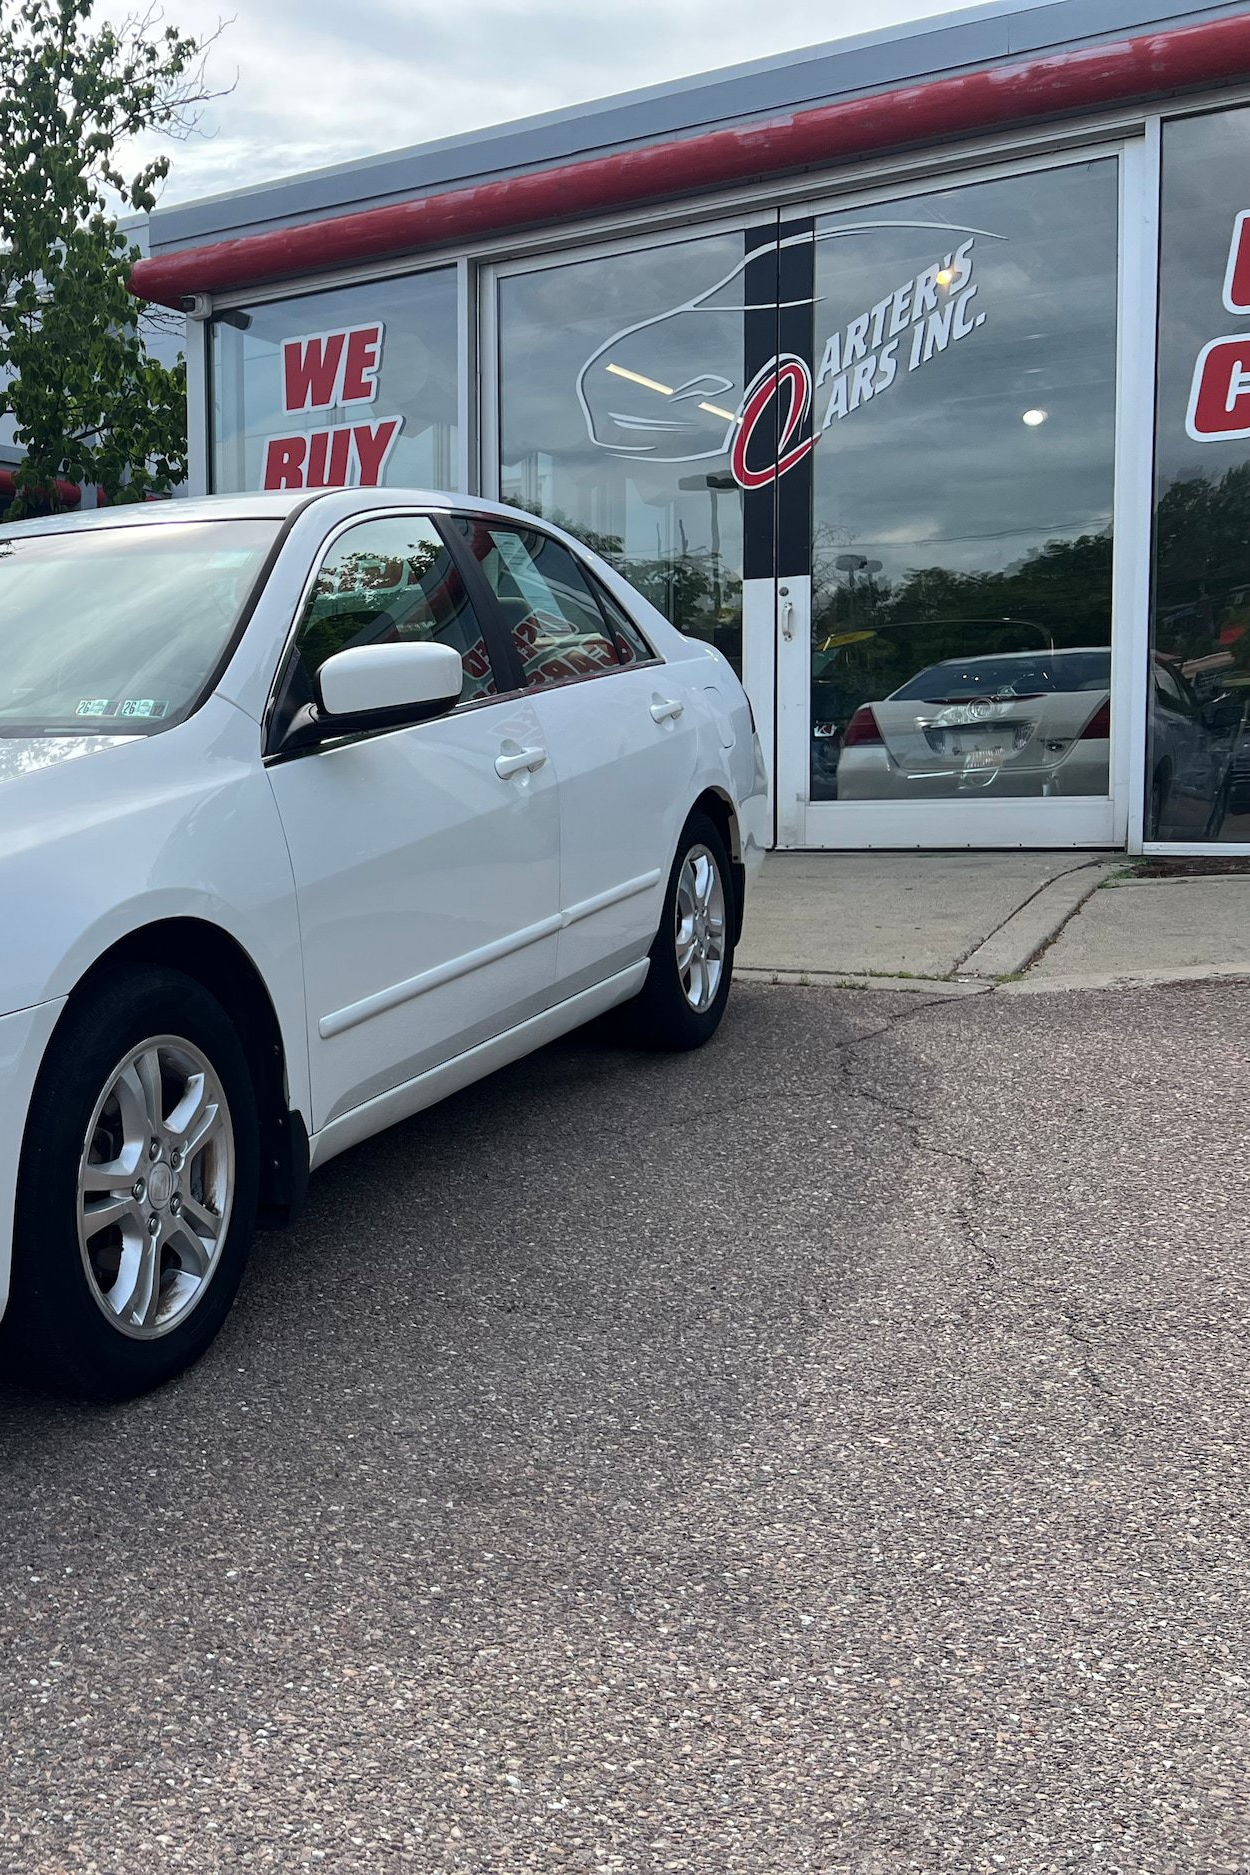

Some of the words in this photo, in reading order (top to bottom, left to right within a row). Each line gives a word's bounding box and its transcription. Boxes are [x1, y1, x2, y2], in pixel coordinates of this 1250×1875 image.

[282, 323, 383, 414] WE
[909, 285, 987, 372] INC.
[262, 417, 402, 491] BUY
[123, 701, 137, 714] 26
